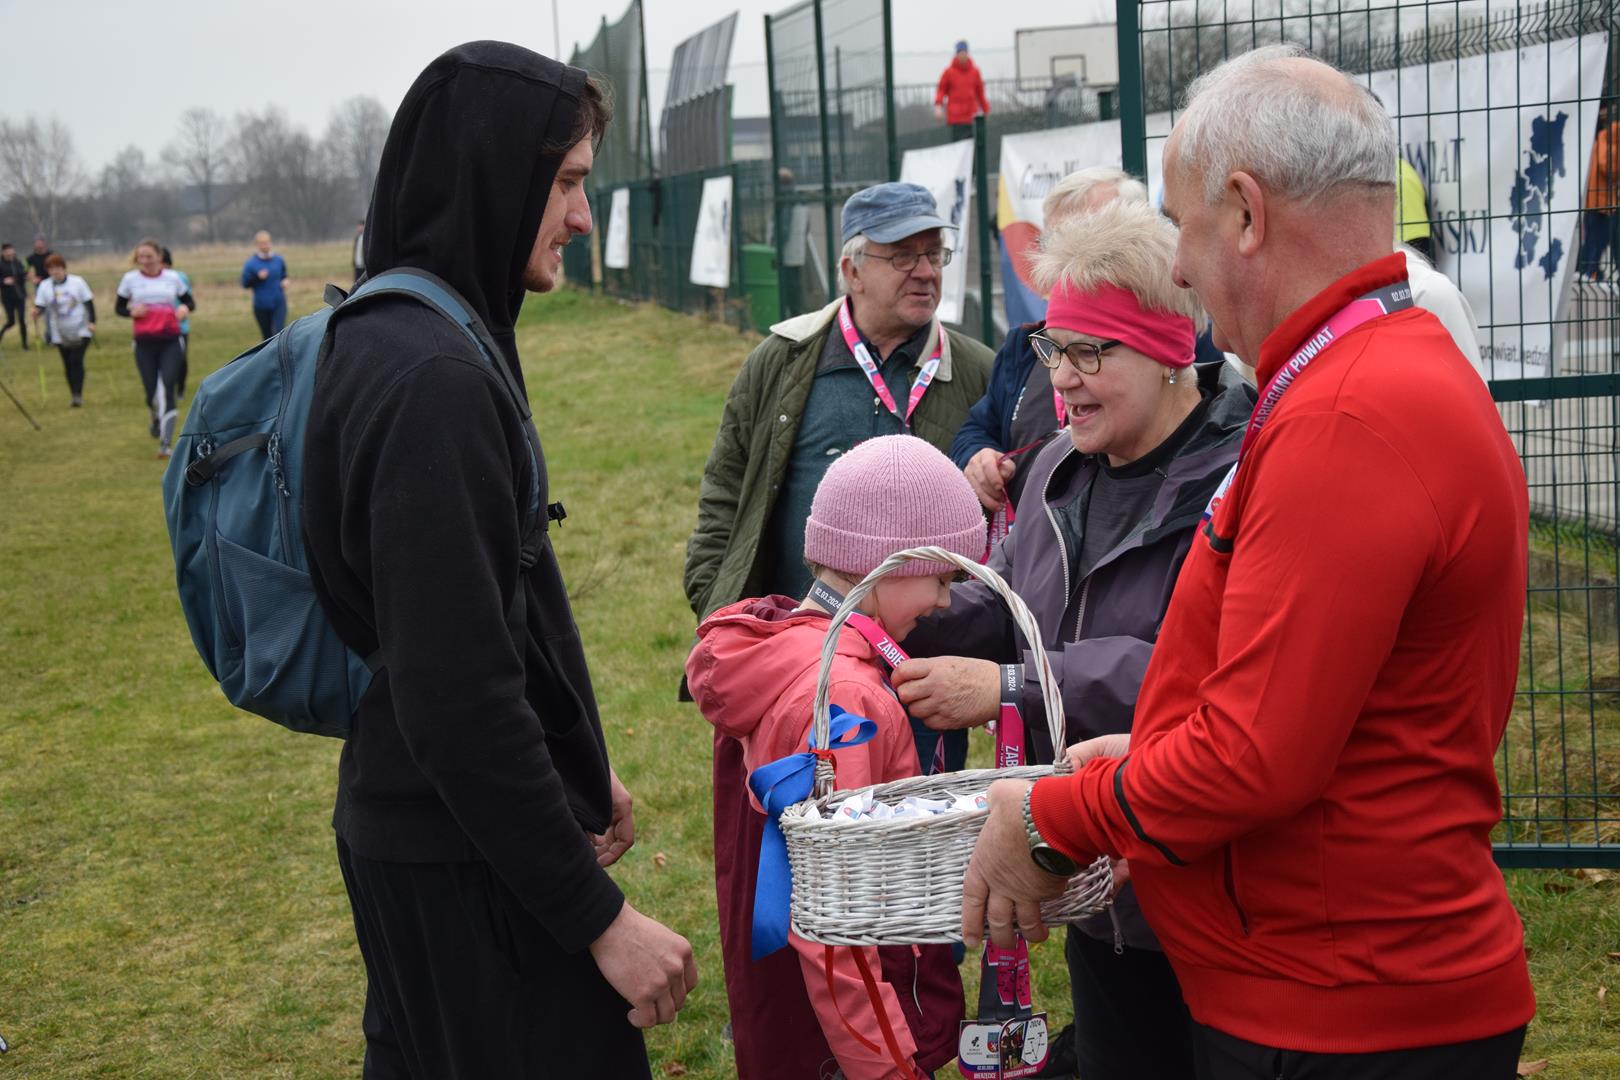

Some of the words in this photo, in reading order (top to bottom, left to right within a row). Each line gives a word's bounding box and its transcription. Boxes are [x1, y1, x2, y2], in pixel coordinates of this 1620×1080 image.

[1289, 326, 1334, 373] POWIAT
[814, 587, 842, 610] 02.03.2024
[877, 637, 905, 668] ZABIE
